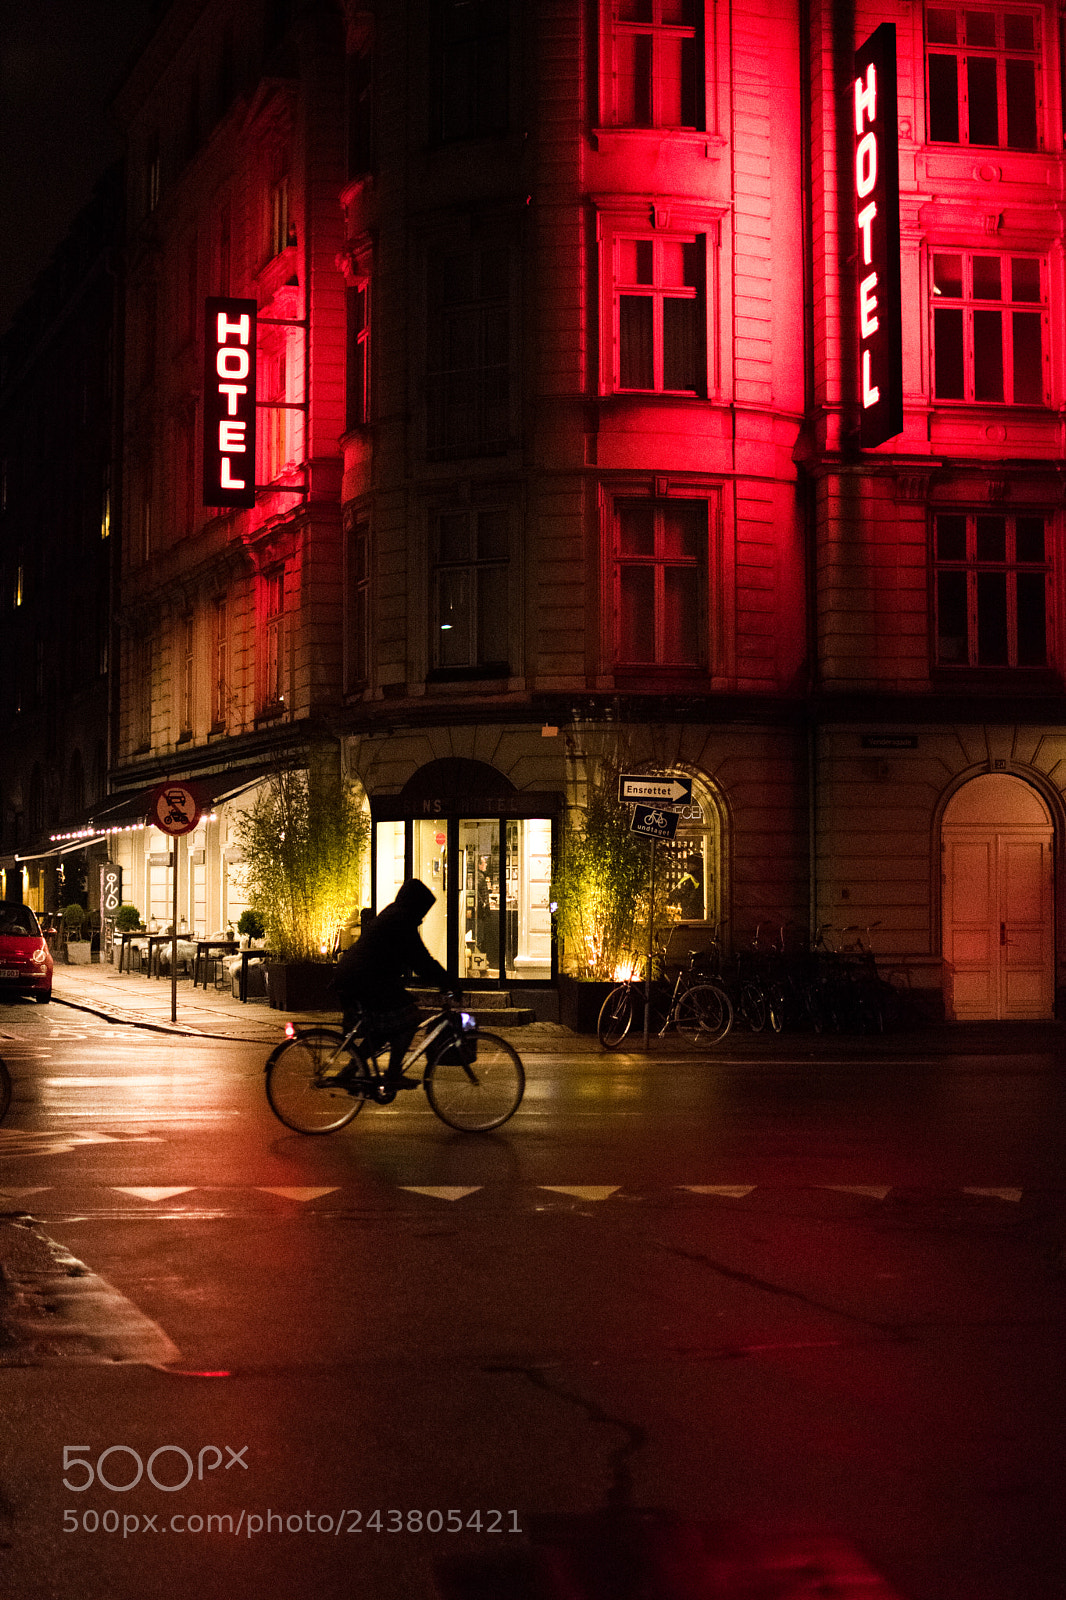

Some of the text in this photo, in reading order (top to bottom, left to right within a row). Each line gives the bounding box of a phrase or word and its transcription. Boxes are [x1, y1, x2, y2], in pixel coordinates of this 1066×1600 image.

[854, 62, 880, 409] HOTEL
[216, 312, 250, 489] HOTEL
[627, 785, 672, 796] Ensrettet
[637, 824, 670, 837] undtaget
